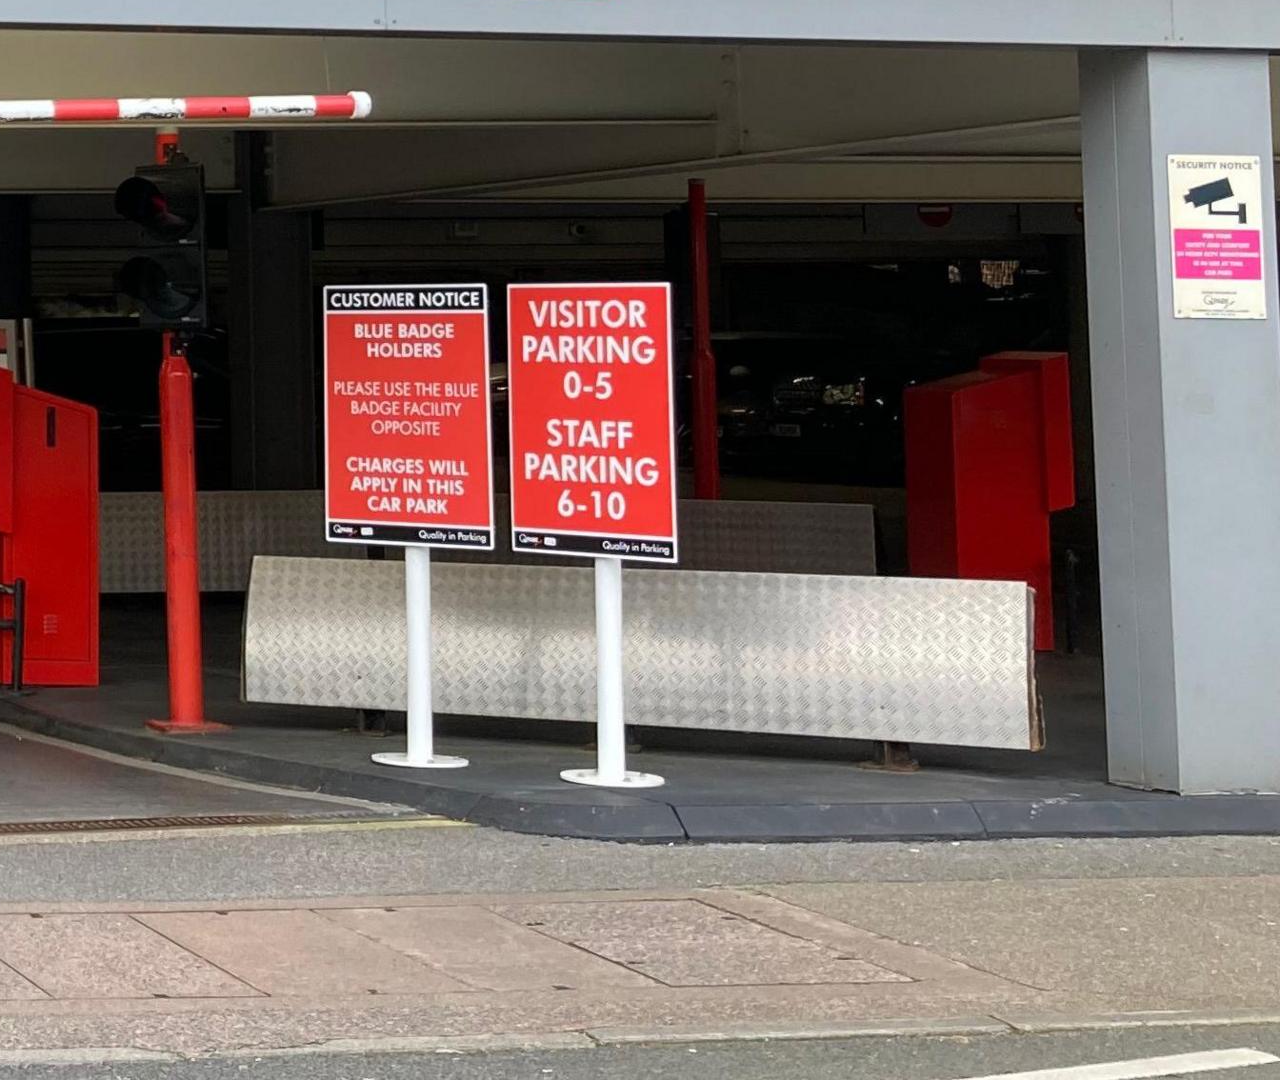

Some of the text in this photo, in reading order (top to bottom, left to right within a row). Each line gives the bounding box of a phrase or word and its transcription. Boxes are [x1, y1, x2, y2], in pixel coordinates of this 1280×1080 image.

[1175, 161, 1253, 171] SECURITY NOTICE
[330, 291, 480, 308] CUSTOMER NOTICE
[527, 299, 647, 329] VISITOR
[354, 323, 455, 339] BLUE BADGE
[366, 342, 443, 359] HOLDERS
[521, 335, 657, 365] PARKING
[333, 381, 479, 398] PLEASE USE THE BLUE
[563, 371, 613, 400] 0-5
[350, 400, 462, 417] BADGE FACILITY
[371, 420, 441, 436] OPPOSITE
[545, 419, 633, 449] STAFF
[345, 457, 469, 476] CHARGES WILL
[524, 452, 660, 486] PARKING
[350, 476, 465, 496] APPLY IN THIS
[366, 495, 448, 514] CAR PARK
[556, 489, 627, 521] 6-10
[418, 528, 487, 544] Quality in Parking
[602, 540, 670, 556] Quality in Parking
